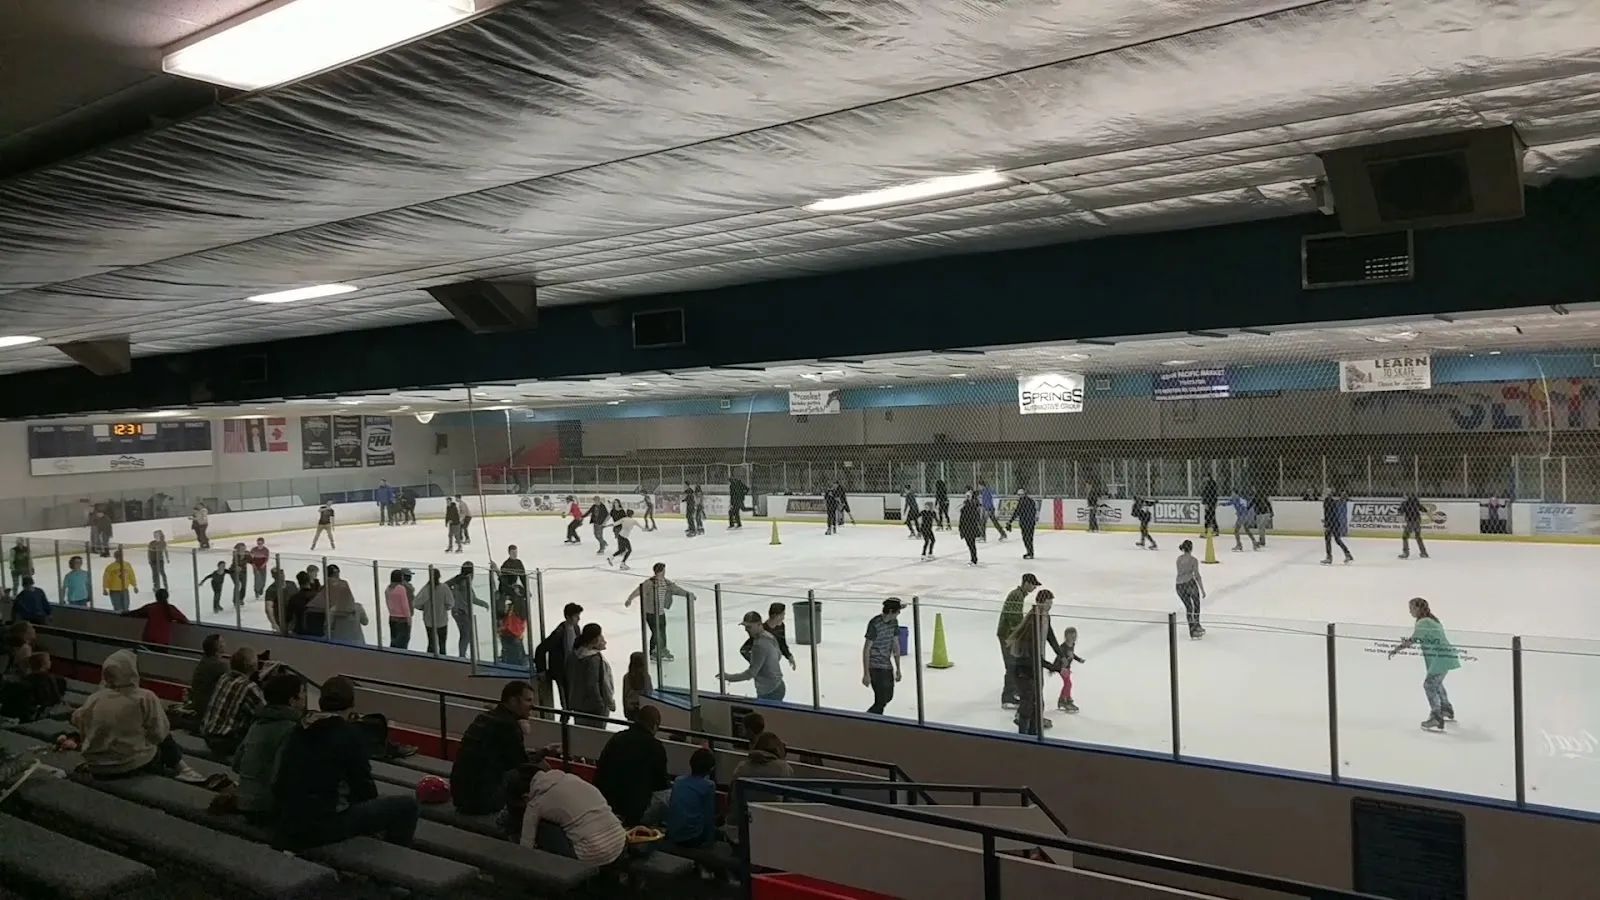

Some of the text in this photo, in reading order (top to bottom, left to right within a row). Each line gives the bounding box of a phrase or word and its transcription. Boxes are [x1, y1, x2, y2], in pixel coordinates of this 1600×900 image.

[1375, 357, 1427, 368] LEARN
[1383, 367, 1415, 377] TO SKATE
[1022, 388, 1082, 406] SPRINGS
[114, 424, 142, 435] 12:31
[367, 435, 392, 448] PHL
[1077, 508, 1121, 519] SPNGS
[1155, 504, 1199, 519] DICK'S
[1354, 505, 1400, 516] NEWS
[1400, 636, 1441, 645] WARNING
